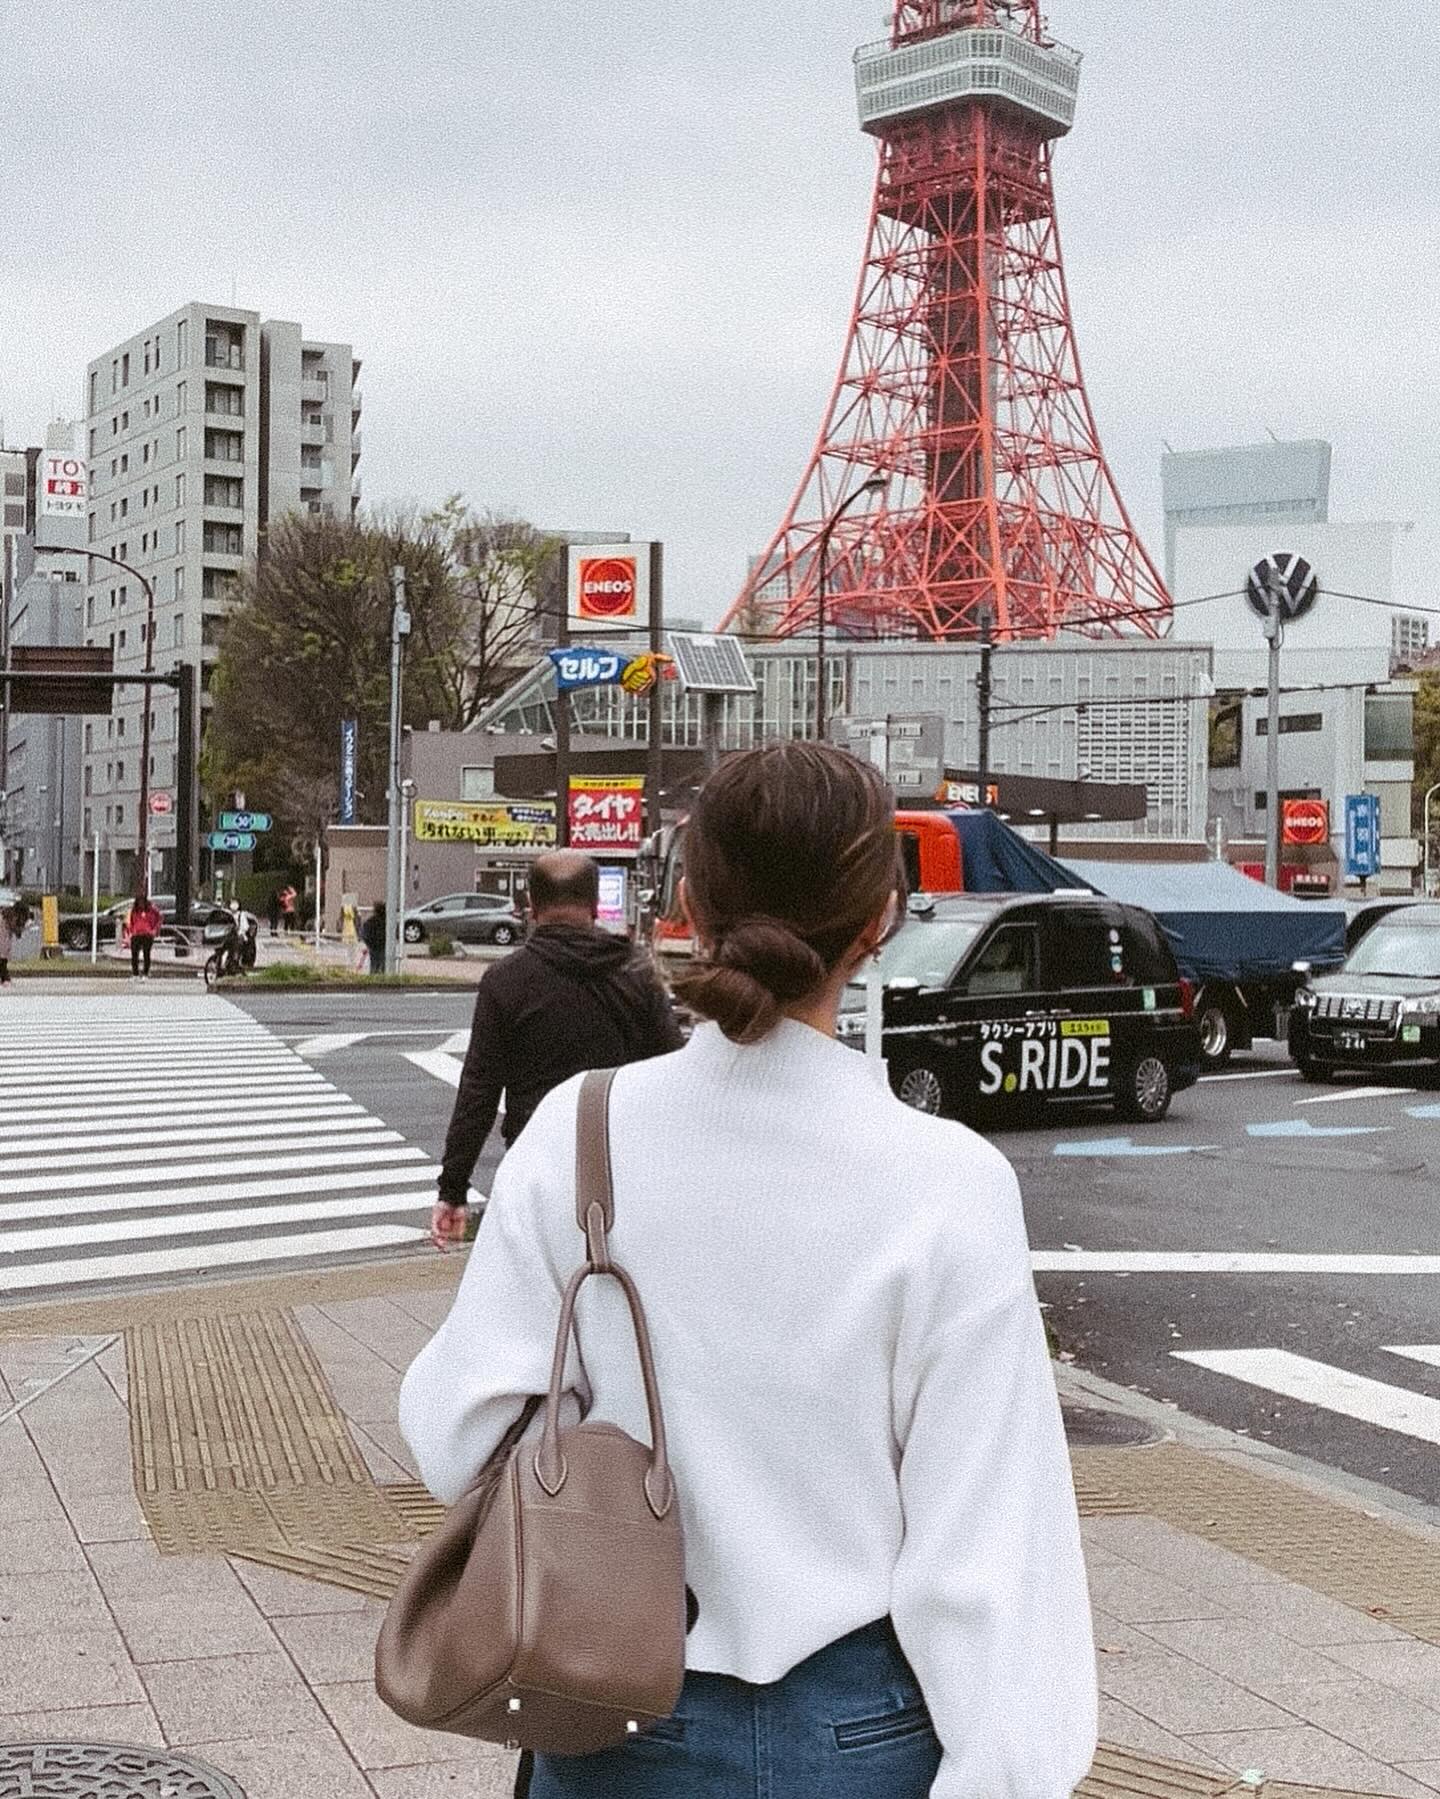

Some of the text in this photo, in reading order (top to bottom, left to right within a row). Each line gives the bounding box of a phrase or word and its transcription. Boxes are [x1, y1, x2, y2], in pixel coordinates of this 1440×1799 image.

[584, 580, 632, 593] ENEOS
[559, 656, 619, 680] セルフ
[573, 794, 635, 819] タイヤ
[1285, 816, 1323, 828] ENEOS
[980, 1021, 1057, 1040] タクシーアプリ
[980, 1037, 1111, 1094] S.RIDE
